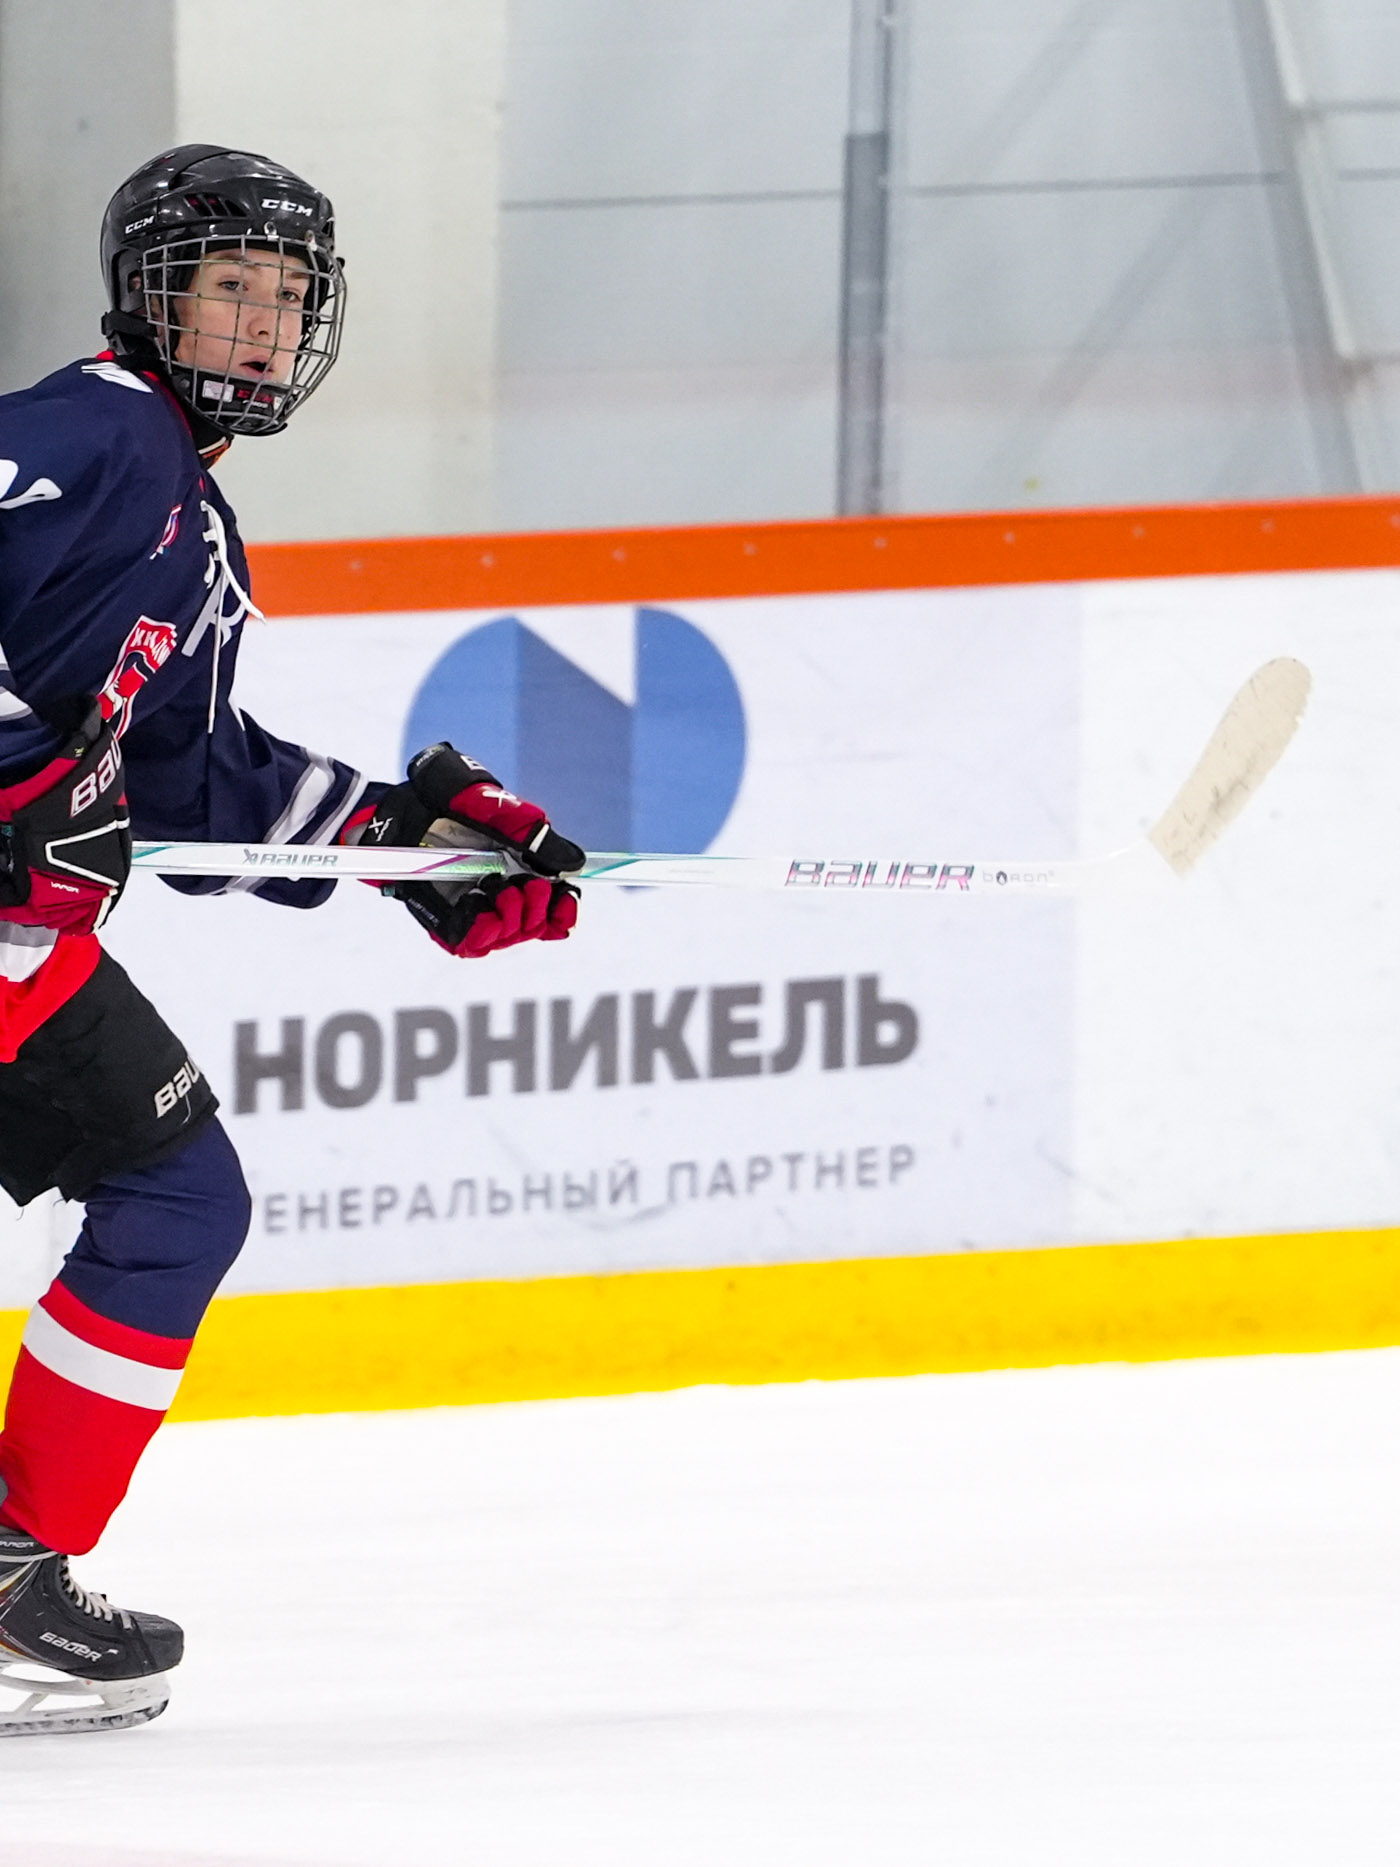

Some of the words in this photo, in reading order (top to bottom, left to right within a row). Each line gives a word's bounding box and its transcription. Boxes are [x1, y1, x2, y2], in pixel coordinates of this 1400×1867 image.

[125, 215, 155, 234] CCM
[260, 199, 313, 216] CCM
[232, 972, 921, 1118] НОРНИКЕЛЬ
[262, 1158, 640, 1236] ЕНЕРАЛЬНЫЙ
[666, 1143, 916, 1201] ПАРТНЕР
